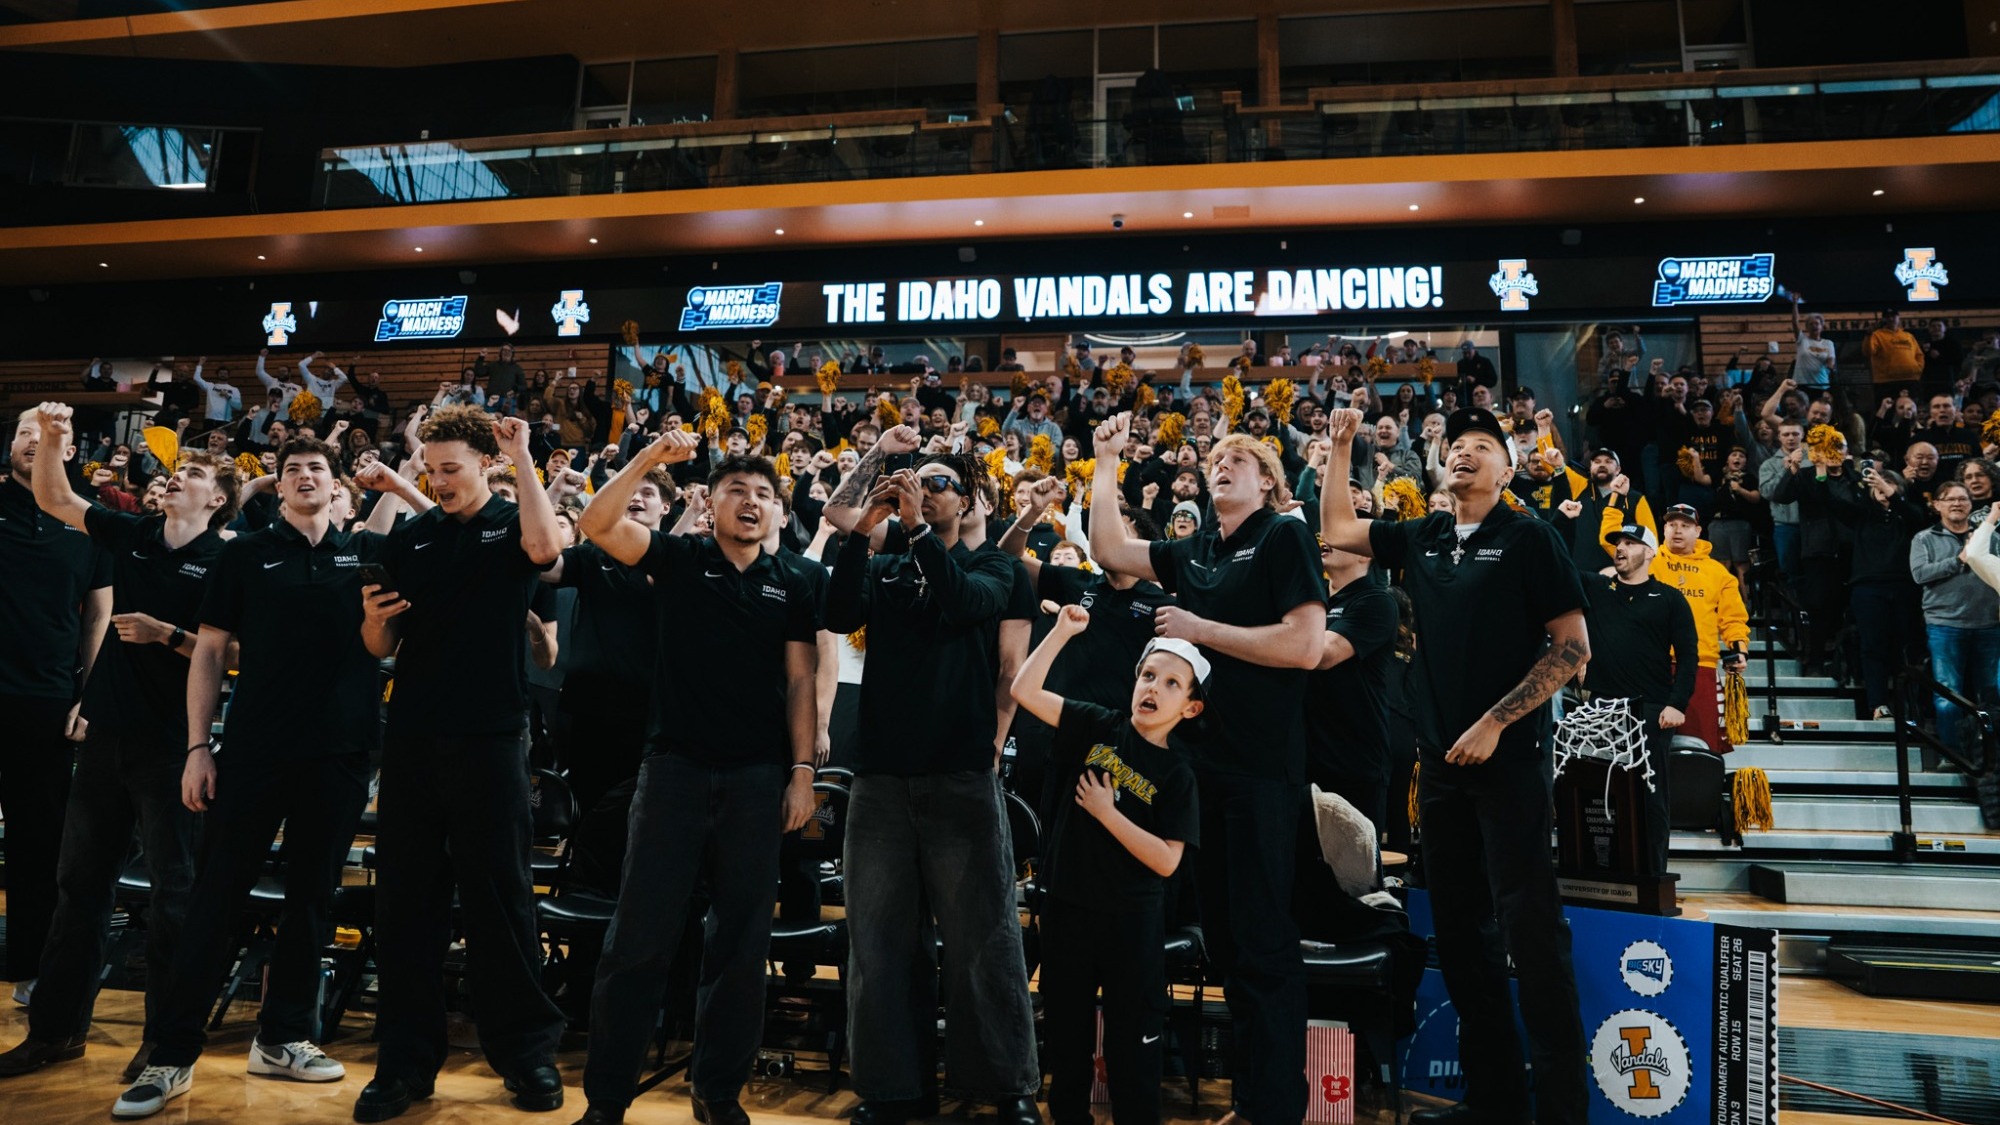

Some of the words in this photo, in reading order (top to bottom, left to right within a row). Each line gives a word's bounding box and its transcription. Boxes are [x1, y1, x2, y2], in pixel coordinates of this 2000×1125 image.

[1680, 260, 1741, 279] MARCH
[1688, 276, 1771, 296] MADNESS
[703, 288, 755, 306] MARCH
[822, 282, 886, 323] THE
[898, 278, 1001, 321] IDAHO
[1014, 273, 1172, 318] VANDALS
[1184, 271, 1255, 313] ARE
[1267, 266, 1444, 311] DANCING!
[397, 302, 443, 318] MARCH
[708, 303, 777, 321] MADNESS
[401, 315, 462, 332] MADNESS
[481, 526, 508, 538] IDAHO
[333, 554, 359, 563] IDAHO
[1476, 548, 1503, 557] IDAHO
[181, 562, 207, 575] IDAHO
[1667, 561, 1699, 574] IDAHO
[762, 584, 787, 597] IDAHO
[1131, 601, 1153, 612] IDAHO
[1562, 884, 1600, 894] UNIVERSITY
[1601, 887, 1610, 895] OF
[1610, 889, 1632, 897] IDAHO
[1733, 937, 1743, 953] 26
[1720, 935, 1731, 991] QUALIFIER
[1732, 954, 1742, 982] SEAT
[1719, 992, 1729, 1054] AUTOMATIC
[1731, 1020, 1742, 1034] 15
[1731, 1034, 1742, 1062] ROW
[1610, 1043, 1671, 1077] Vandals
[1717, 1055, 1729, 1125] TOURNAMENT
[1730, 1100, 1741, 1110] 3
